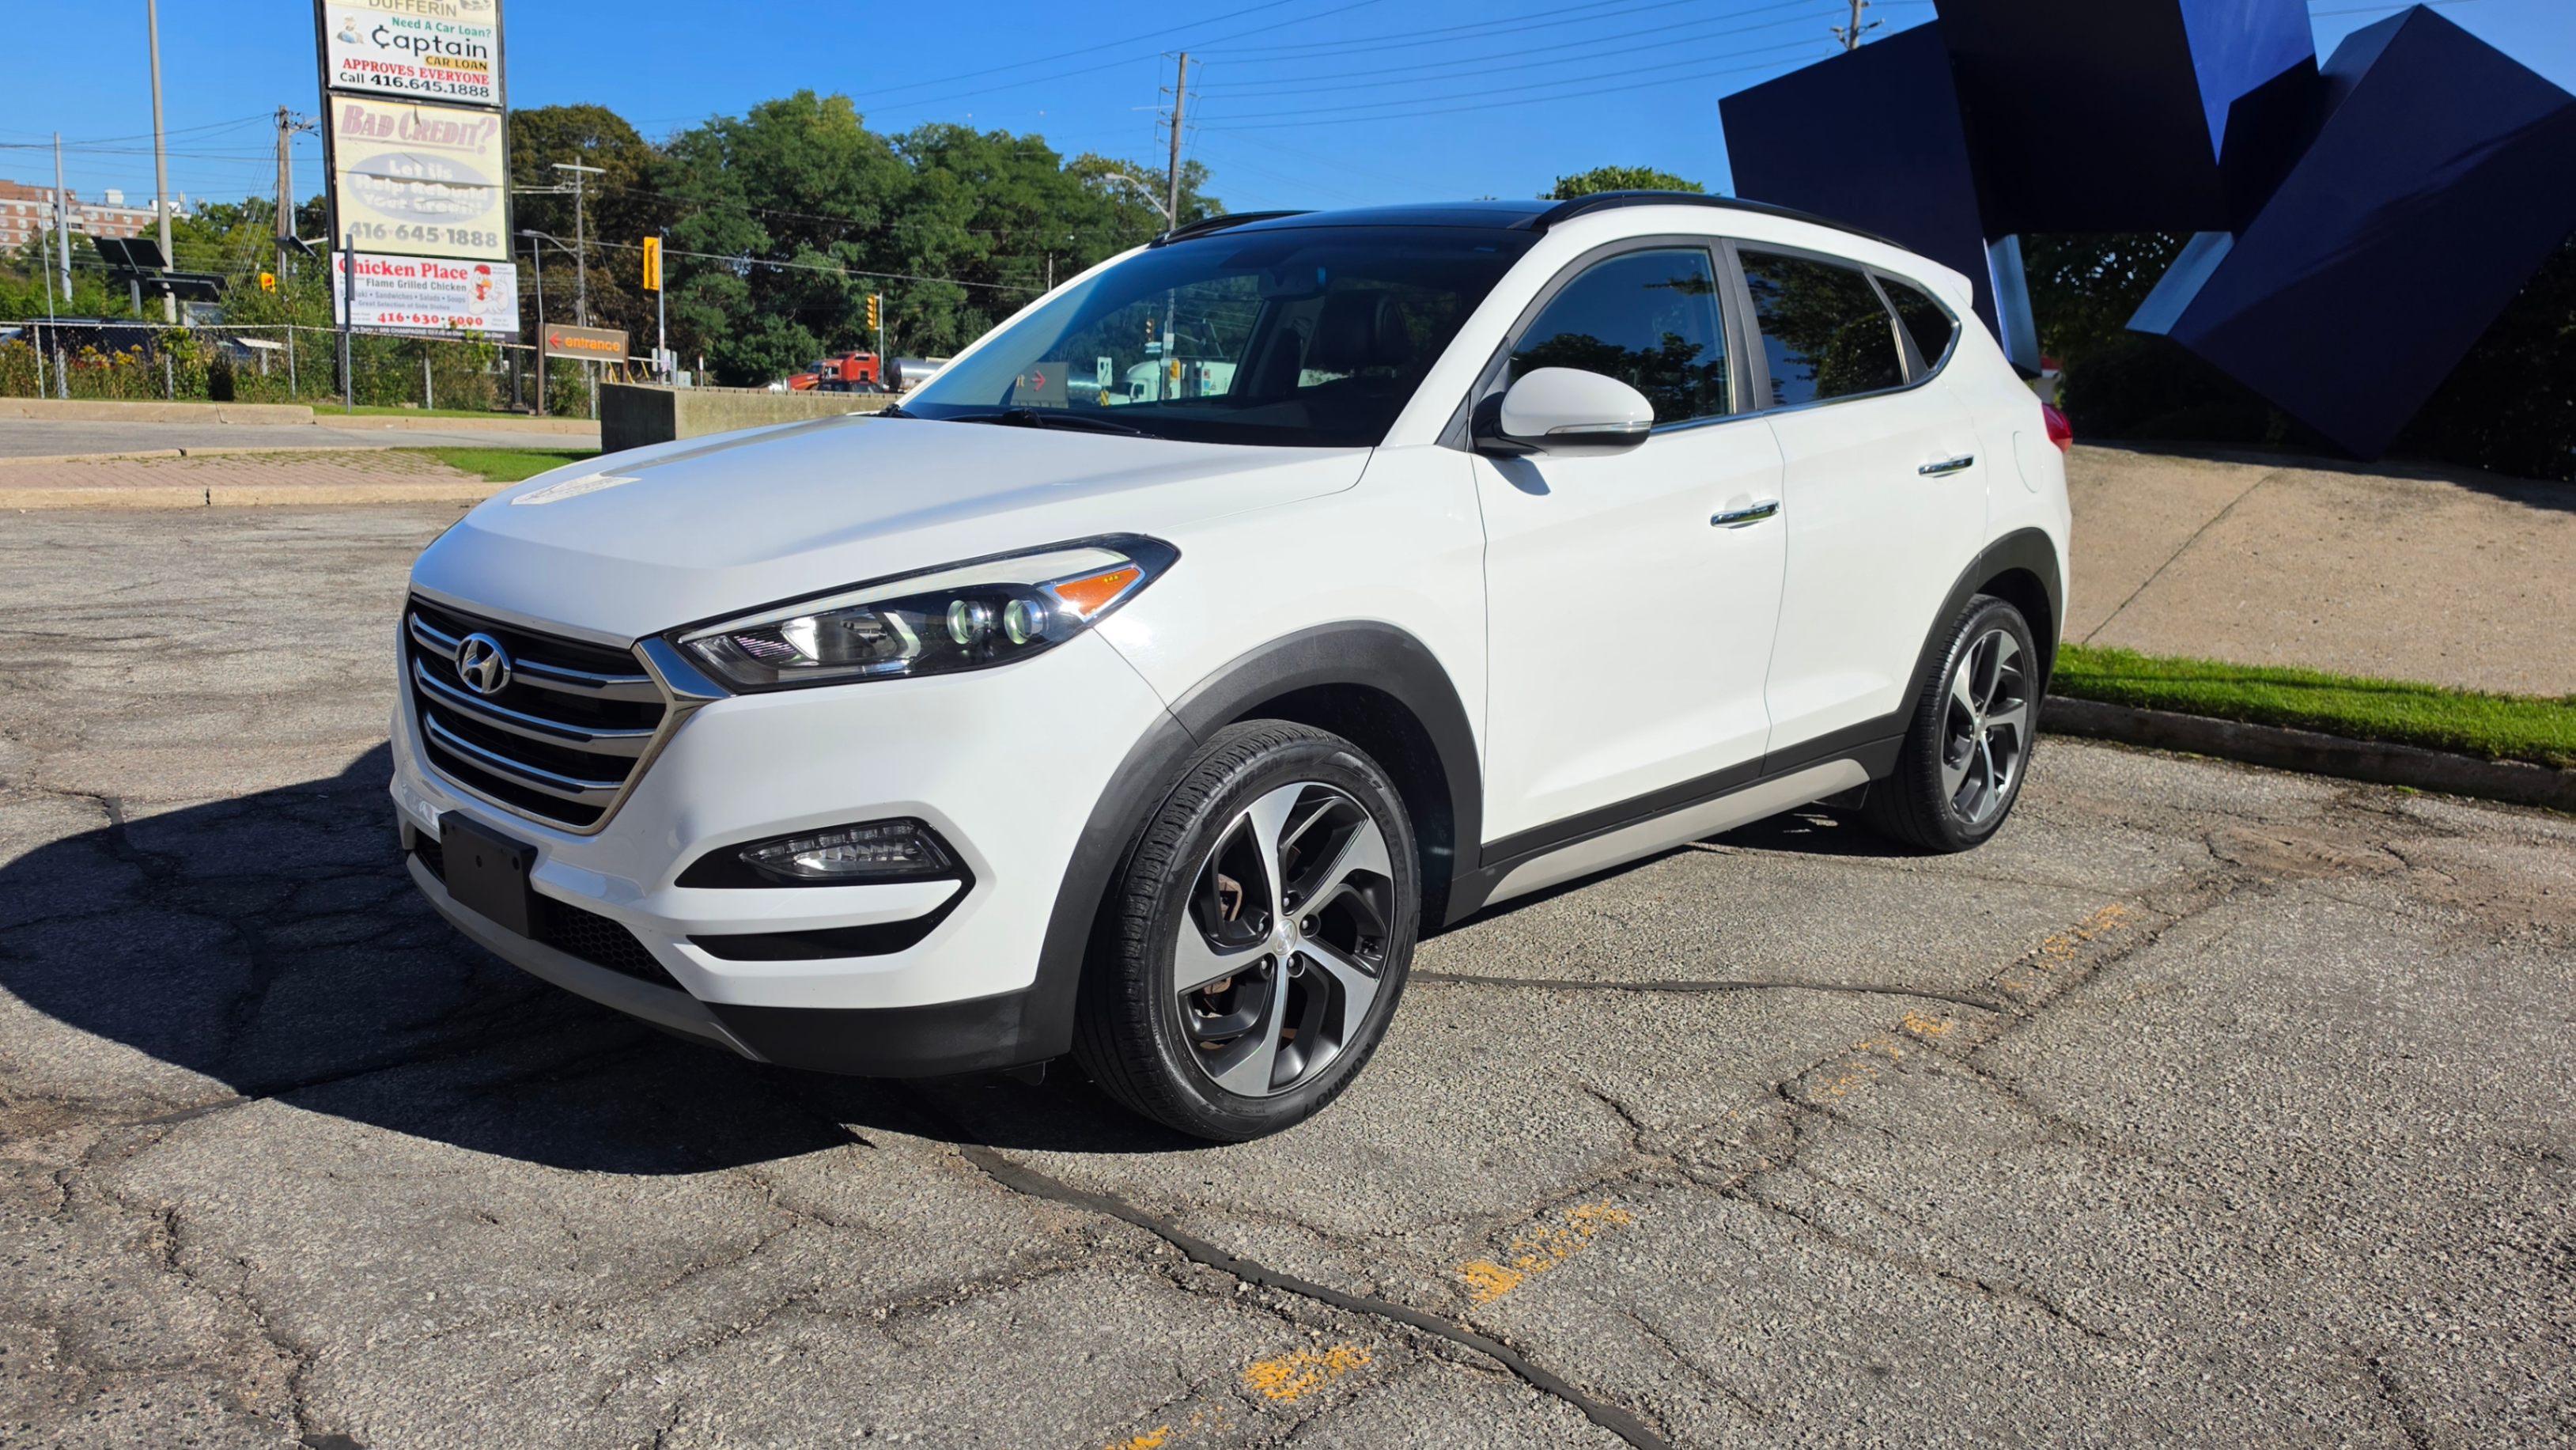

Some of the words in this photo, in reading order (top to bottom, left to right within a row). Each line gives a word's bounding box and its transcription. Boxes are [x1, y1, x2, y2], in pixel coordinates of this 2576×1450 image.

[369, 0, 457, 17] DUFFERIN
[392, 17, 421, 29] Need
[425, 21, 432, 31] A
[436, 23, 455, 34] Car
[459, 25, 491, 38] Loan?
[372, 25, 487, 59] Captain
[342, 58, 414, 77] APPROVES
[419, 67, 490, 85] EVERYONE
[426, 56, 450, 68] CAR
[455, 60, 487, 70] LOAN
[340, 72, 365, 83] Call
[370, 74, 490, 97] 416.645.1888
[340, 104, 395, 138] BAD
[398, 111, 498, 155] CREDIT?
[389, 159, 423, 176] Let
[428, 163, 452, 180] Us
[339, 258, 416, 278] Chicken
[421, 263, 468, 279] Place
[366, 278, 395, 289] Flame
[398, 279, 428, 290] Grilled
[430, 282, 467, 291] Chicken
[375, 292, 413, 301] Sandwiches
[564, 336, 621, 352] entrance
[1316, 1043, 1373, 1106] KUMHO
